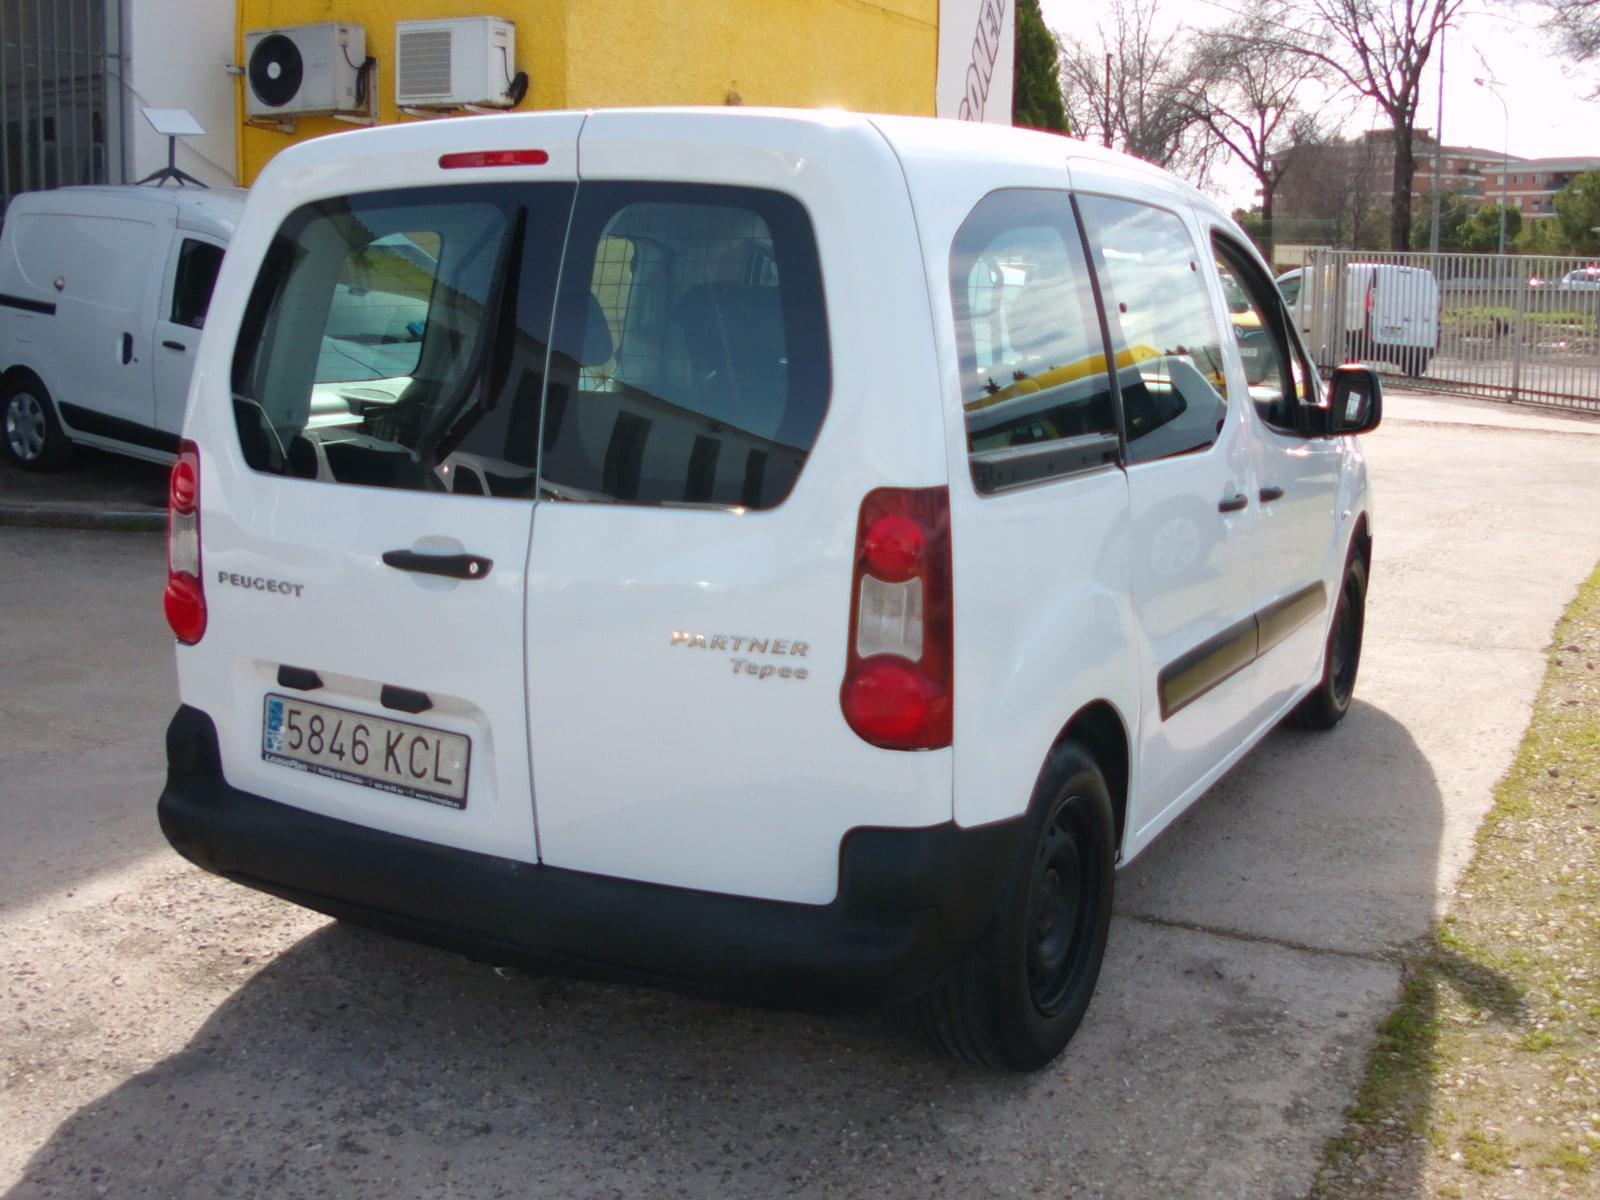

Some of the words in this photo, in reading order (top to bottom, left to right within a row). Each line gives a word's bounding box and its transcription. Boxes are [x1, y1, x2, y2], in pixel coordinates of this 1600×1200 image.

[218, 571, 304, 597] PEUGEOT
[670, 630, 810, 656] PARTNER
[730, 657, 809, 680] Tepee
[287, 709, 370, 765] 5846
[384, 730, 453, 785] KCL
